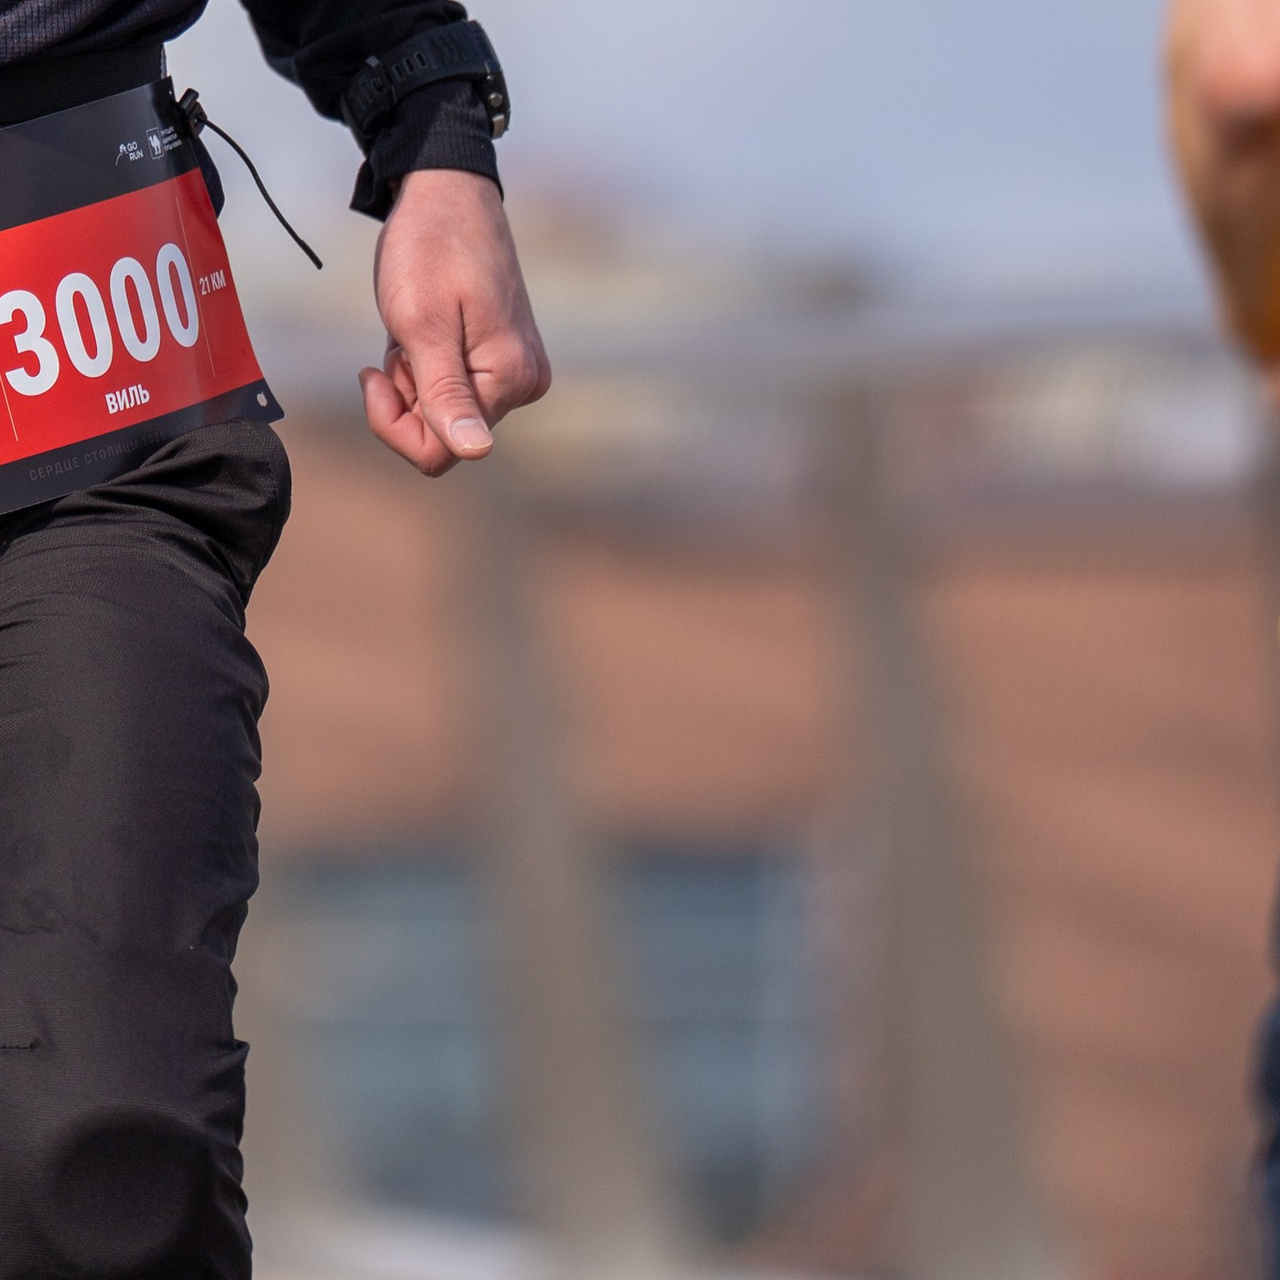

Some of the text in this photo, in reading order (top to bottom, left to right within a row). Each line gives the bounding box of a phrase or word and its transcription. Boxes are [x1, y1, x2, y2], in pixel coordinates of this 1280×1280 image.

[127, 141, 138, 151] GO
[129, 149, 144, 161] RUN
[199, 274, 210, 296] 21
[104, 383, 151, 415] ВИЛЬ
[29, 457, 80, 481] СЕРДЦЕ
[84, 440, 138, 465] СТОЛИЦЫ
